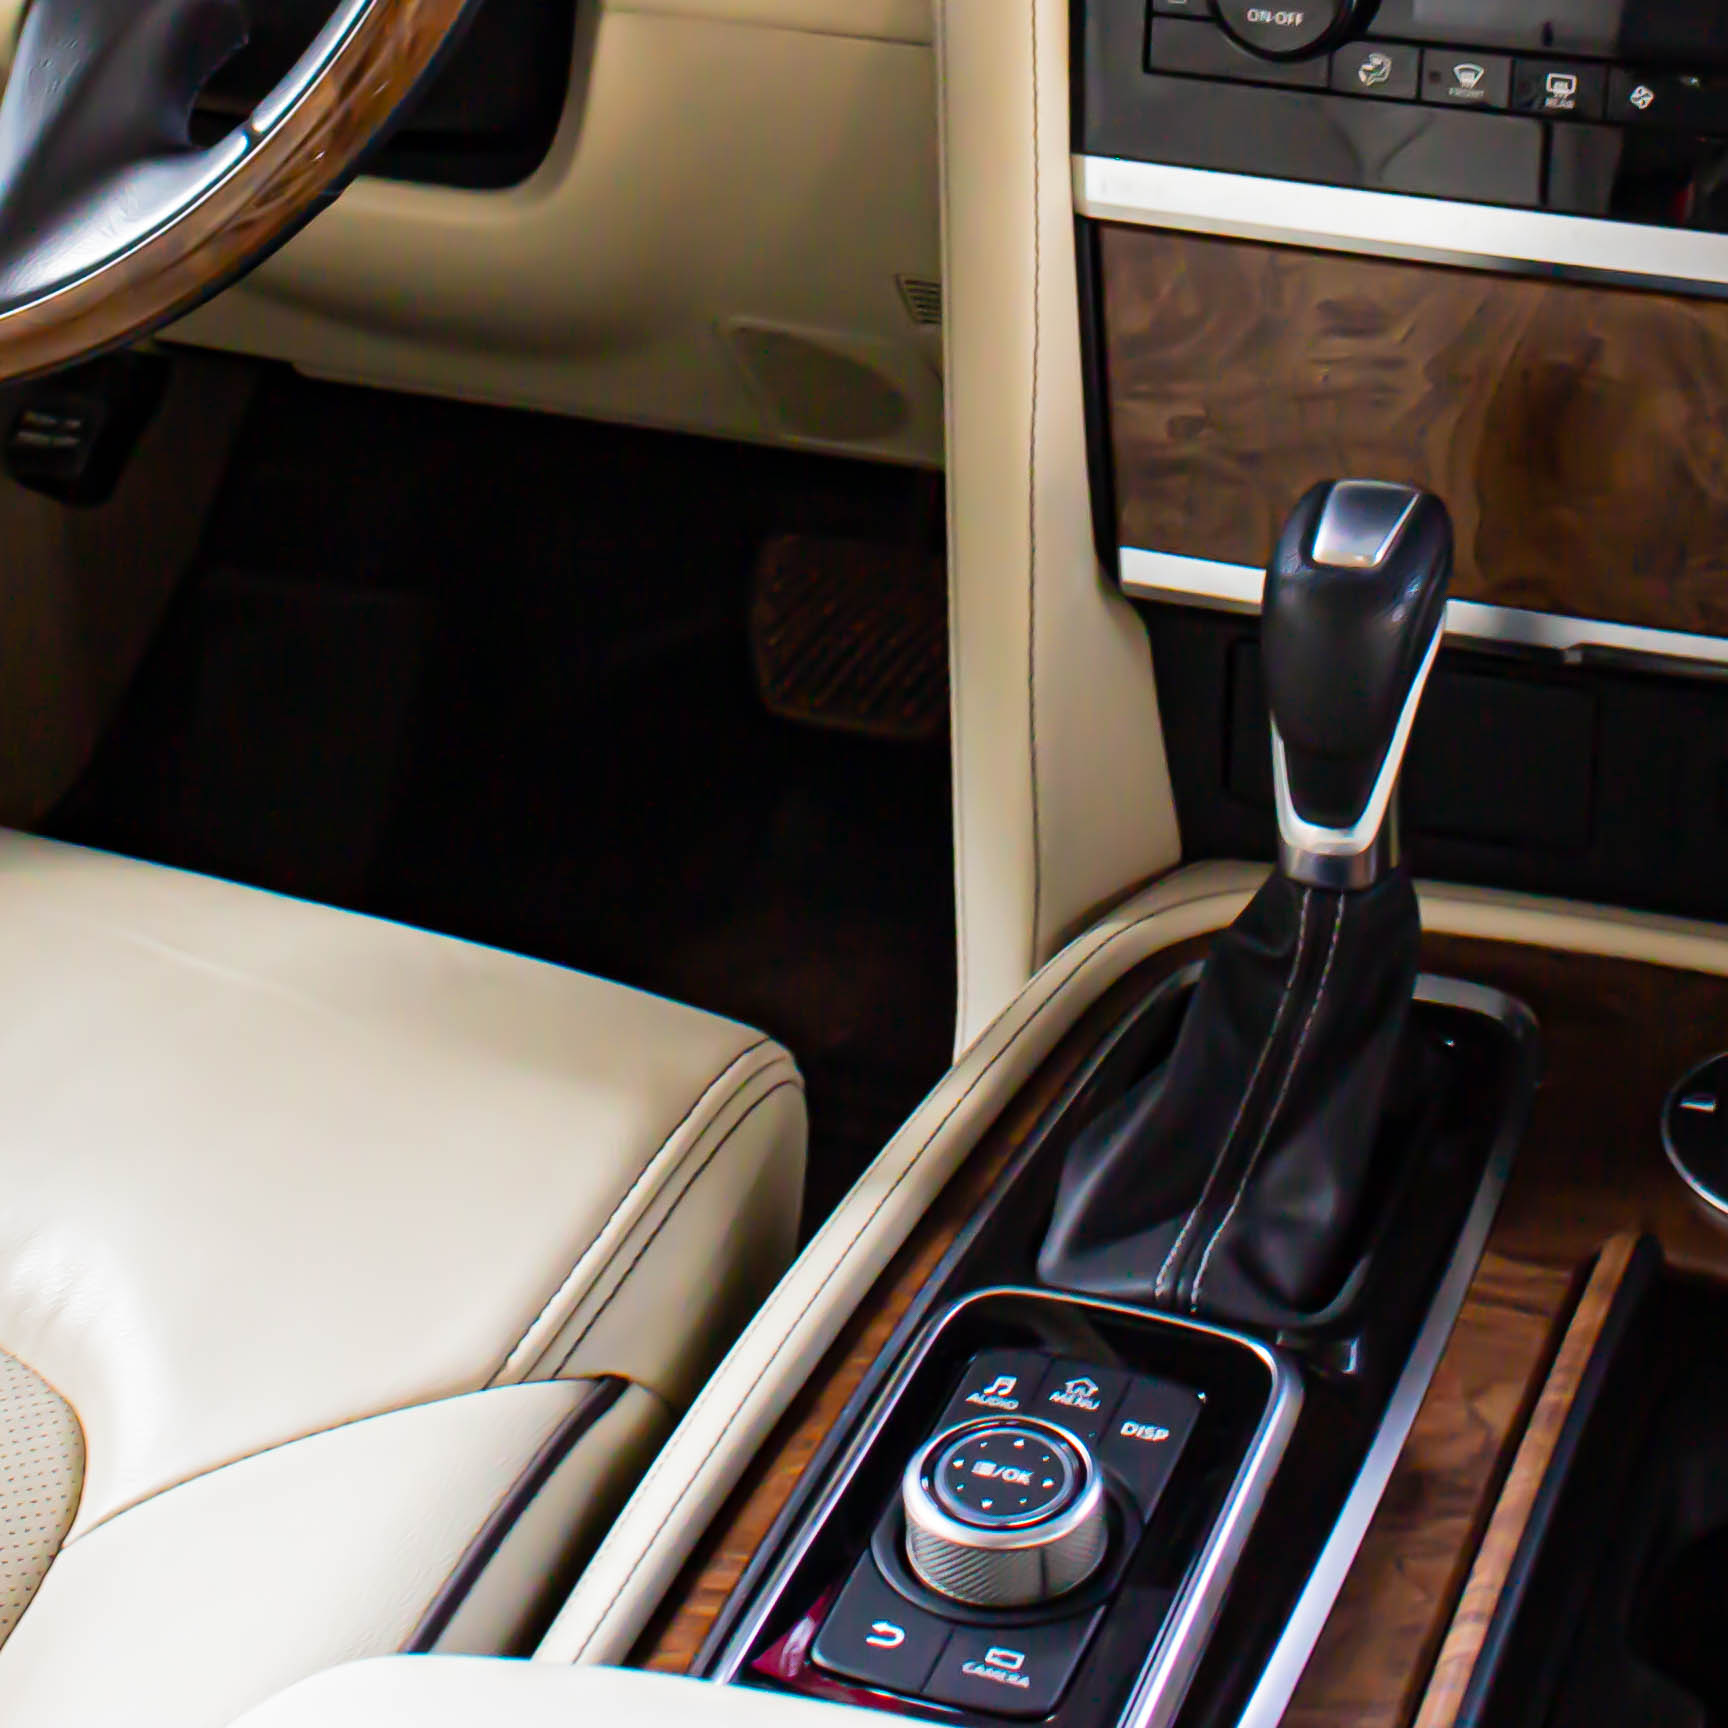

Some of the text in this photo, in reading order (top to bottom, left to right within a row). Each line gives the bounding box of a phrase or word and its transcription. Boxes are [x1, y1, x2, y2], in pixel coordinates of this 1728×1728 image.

[965, 1391, 1020, 1412] AUDIO
[1048, 1390, 1102, 1412] MENU
[1120, 1419, 1171, 1443] DISP
